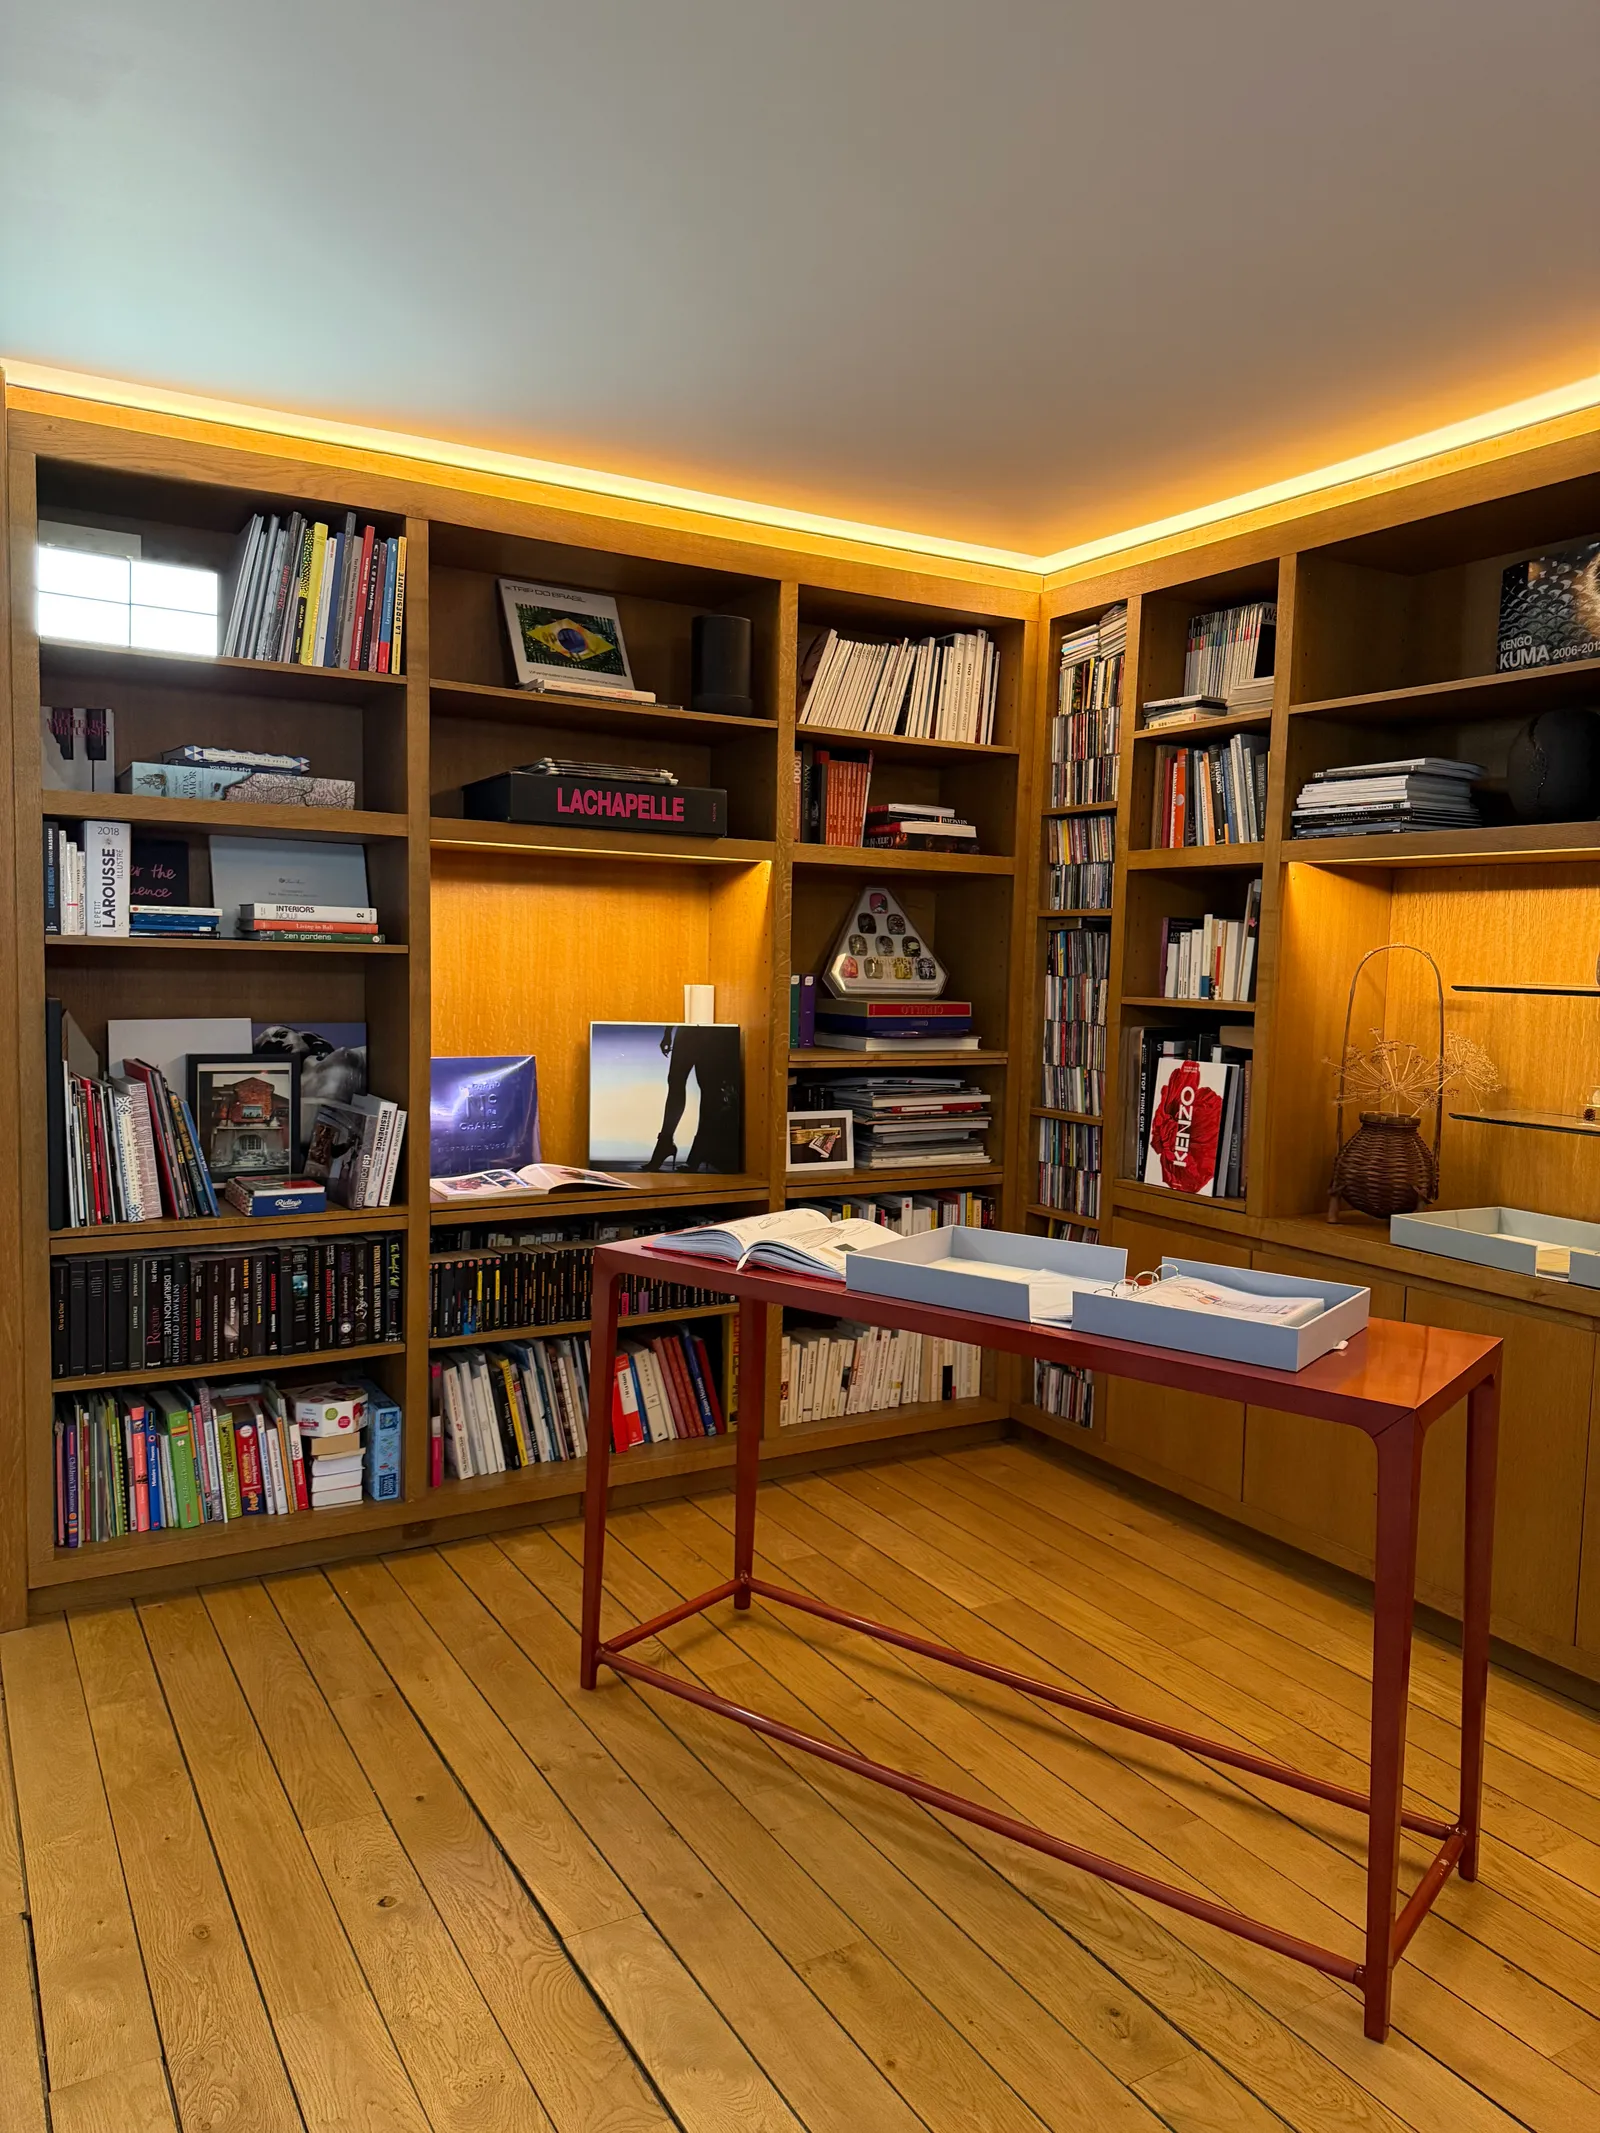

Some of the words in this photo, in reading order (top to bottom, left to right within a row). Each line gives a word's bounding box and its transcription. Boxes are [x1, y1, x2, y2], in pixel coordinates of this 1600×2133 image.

[396, 572, 405, 622] PRÉSIDENTE
[395, 624, 402, 635] LA
[1500, 635, 1533, 652] KENGO
[1499, 644, 1550, 670] KUMA
[1214, 761, 1222, 794] INTERIORS
[1257, 763, 1265, 797] DISPARUE
[557, 787, 684, 822] LACHAPELLE
[97, 826, 120, 836] 2018
[151, 864, 177, 880] the
[101, 848, 116, 928] LAROUSSE
[131, 886, 172, 898] uence
[93, 901, 101, 917] PETIT
[275, 905, 315, 913] INTERIORS
[93, 918, 101, 928] LE
[300, 933, 332, 942] gardens
[900, 1005, 944, 1015] CIPULLO
[375, 1109, 389, 1152] RESIDENCE
[393, 1114, 404, 1147] IMPRESSIONS
[459, 1121, 503, 1130] CHANEL
[1173, 1086, 1195, 1168] KENZO
[164, 1274, 172, 1319] DISRUPTION
[172, 1283, 180, 1322] DAWKINS
[164, 1320, 172, 1335] LIVE
[172, 1325, 180, 1364] RICHARD
[226, 1471, 238, 1516] LAROUSSE
